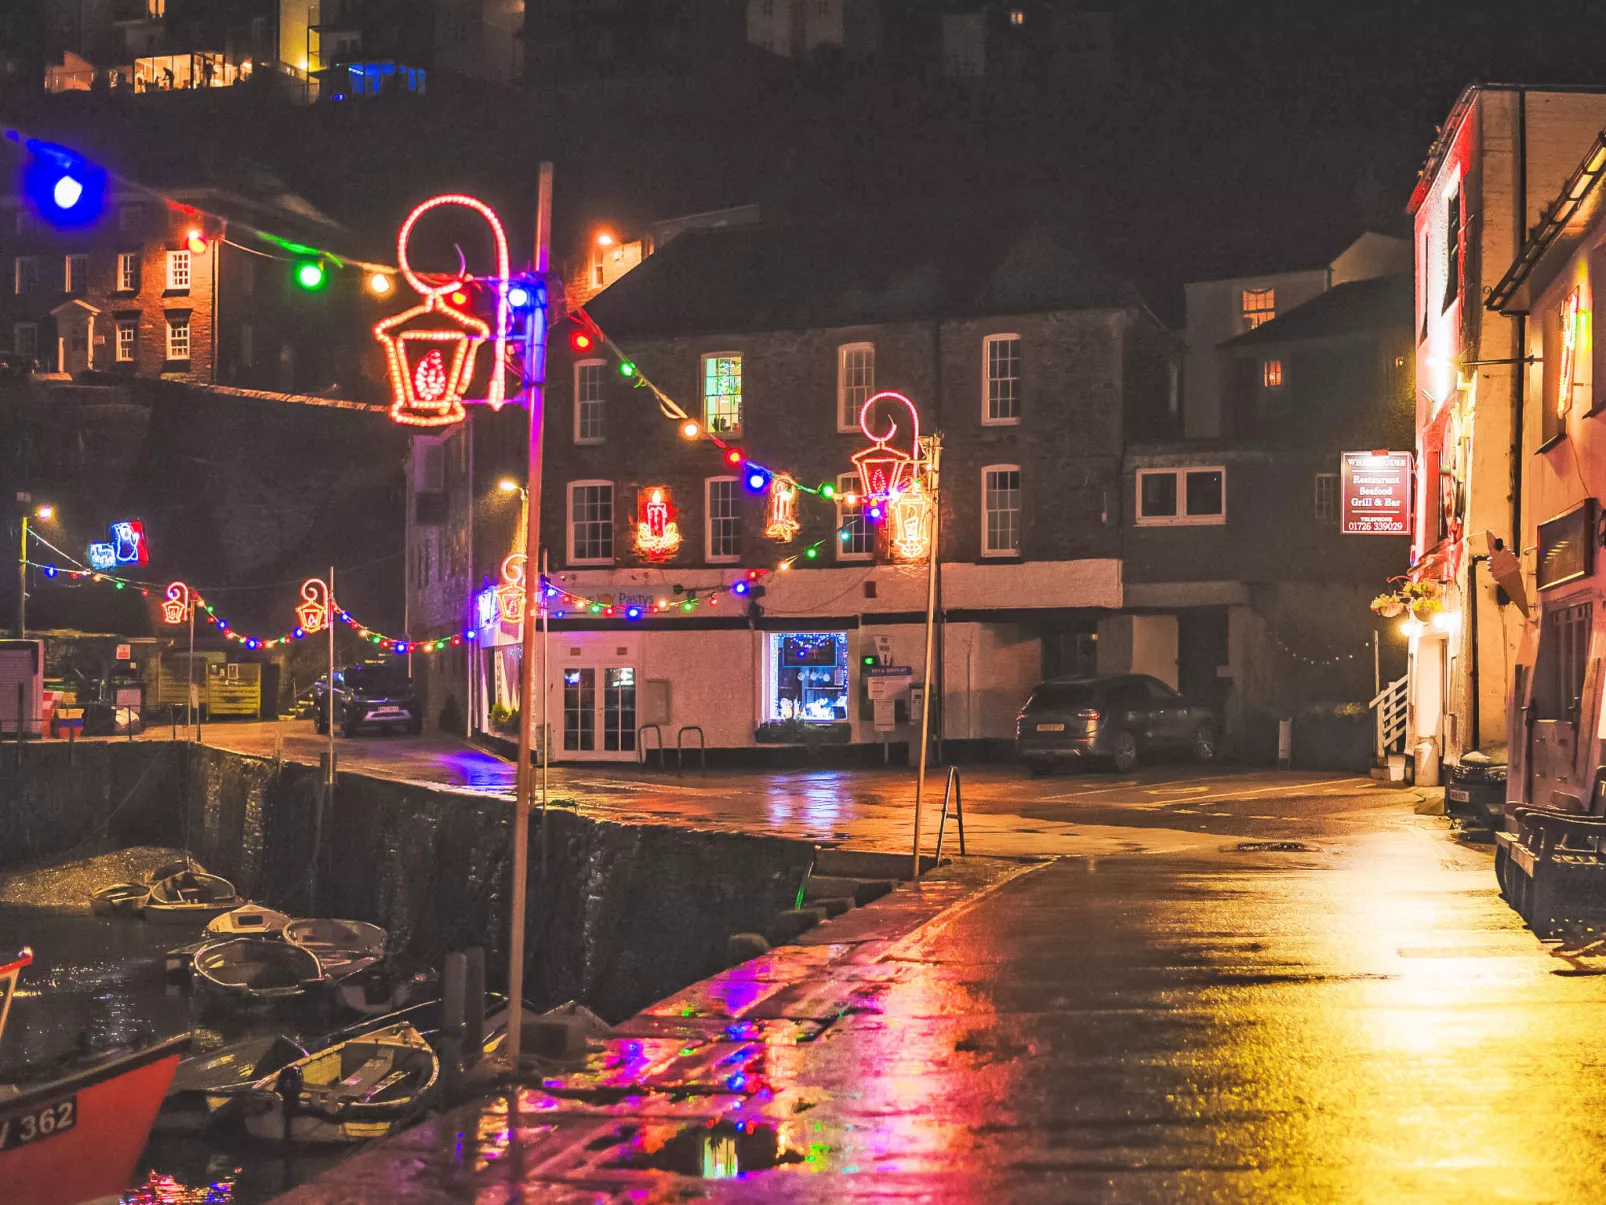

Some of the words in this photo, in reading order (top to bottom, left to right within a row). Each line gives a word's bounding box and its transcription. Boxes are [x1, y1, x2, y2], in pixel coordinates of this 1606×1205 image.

[1353, 476, 1400, 484] Restaurant
[1359, 487, 1392, 496] Seafood
[1351, 497, 1373, 507] Grill
[1374, 498, 1382, 507] &
[1384, 498, 1401, 507] Bar
[1348, 522, 1372, 531] 01726
[1373, 522, 1403, 531] 339029
[619, 592, 654, 607] Pastys
[20, 1102, 73, 1141] 362
